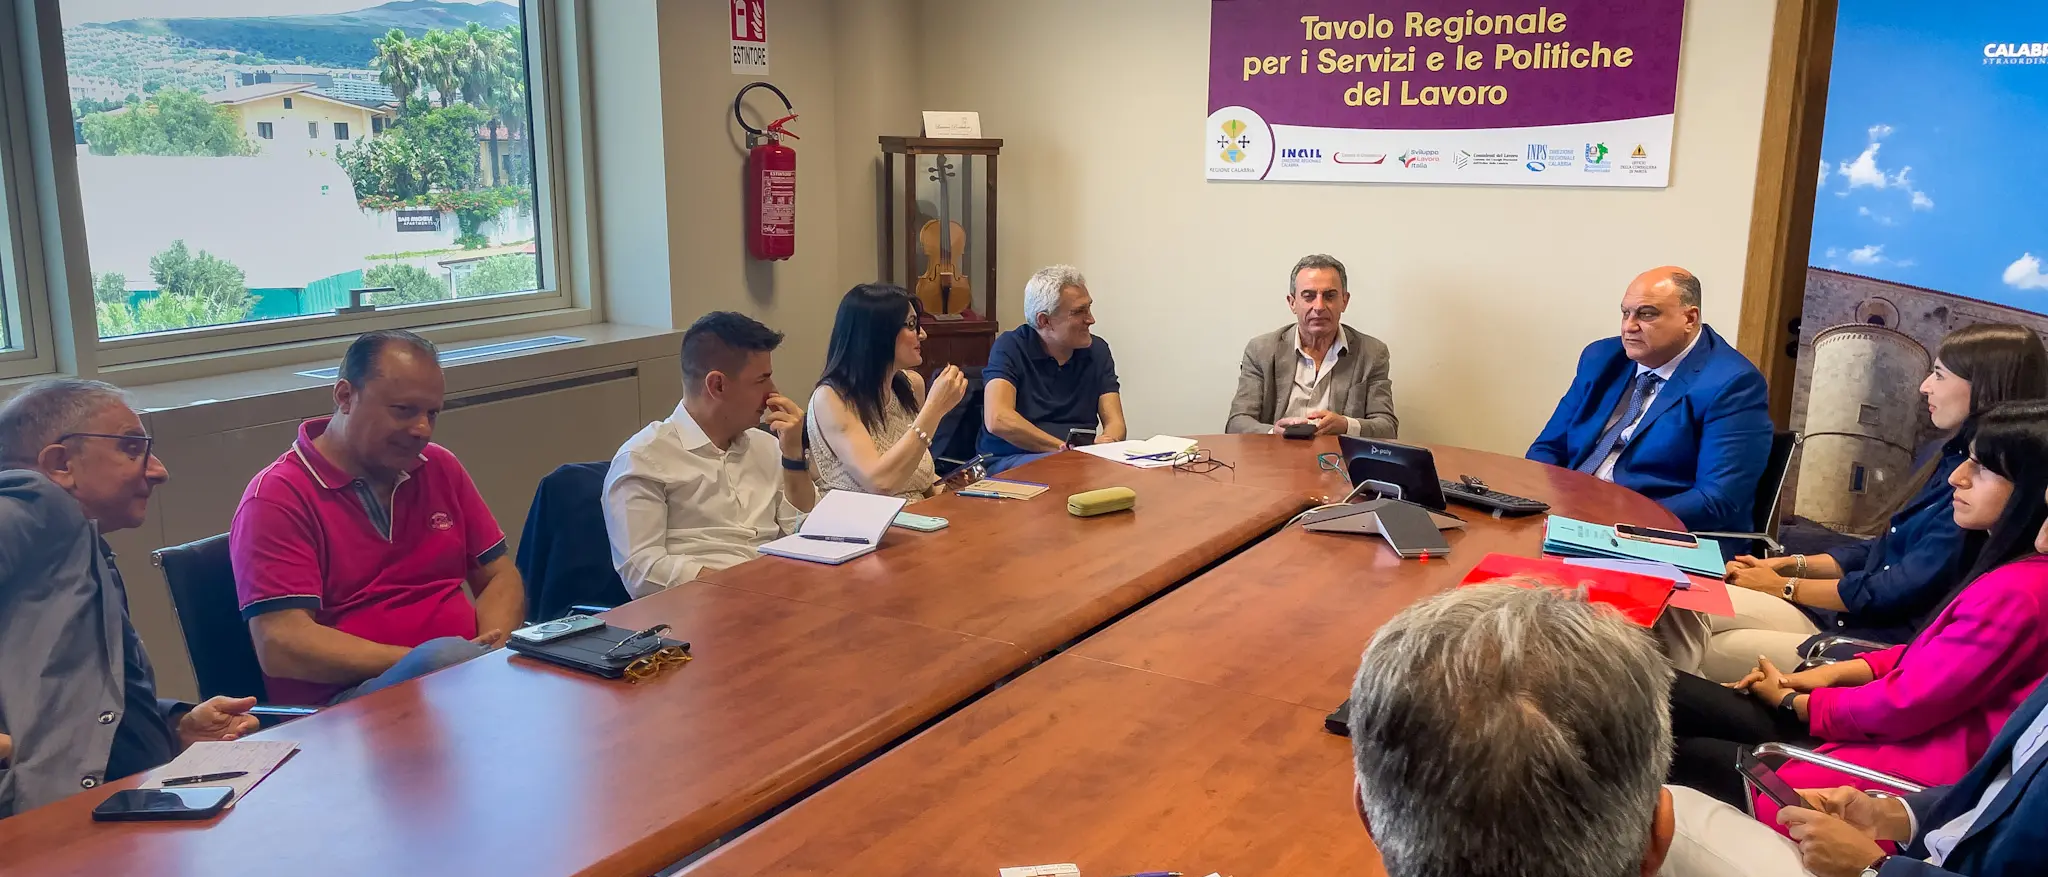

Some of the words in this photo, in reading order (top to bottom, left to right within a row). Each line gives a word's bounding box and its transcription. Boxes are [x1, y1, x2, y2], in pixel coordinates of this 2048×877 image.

[1300, 13, 1394, 41] Tavolo
[1404, 6, 1567, 43] Regionale
[733, 46, 766, 65] ESTINTORE
[1243, 55, 1292, 81] per
[1301, 49, 1308, 74] i
[1317, 46, 1416, 74] Servizi
[1426, 51, 1445, 72] e
[1455, 44, 1483, 71] le
[1495, 41, 1634, 70] Politiche
[1343, 80, 1390, 106] del
[1400, 80, 1507, 106] Lavoro
[1282, 148, 1321, 158] INAIL
[1527, 144, 1547, 160] INPS
